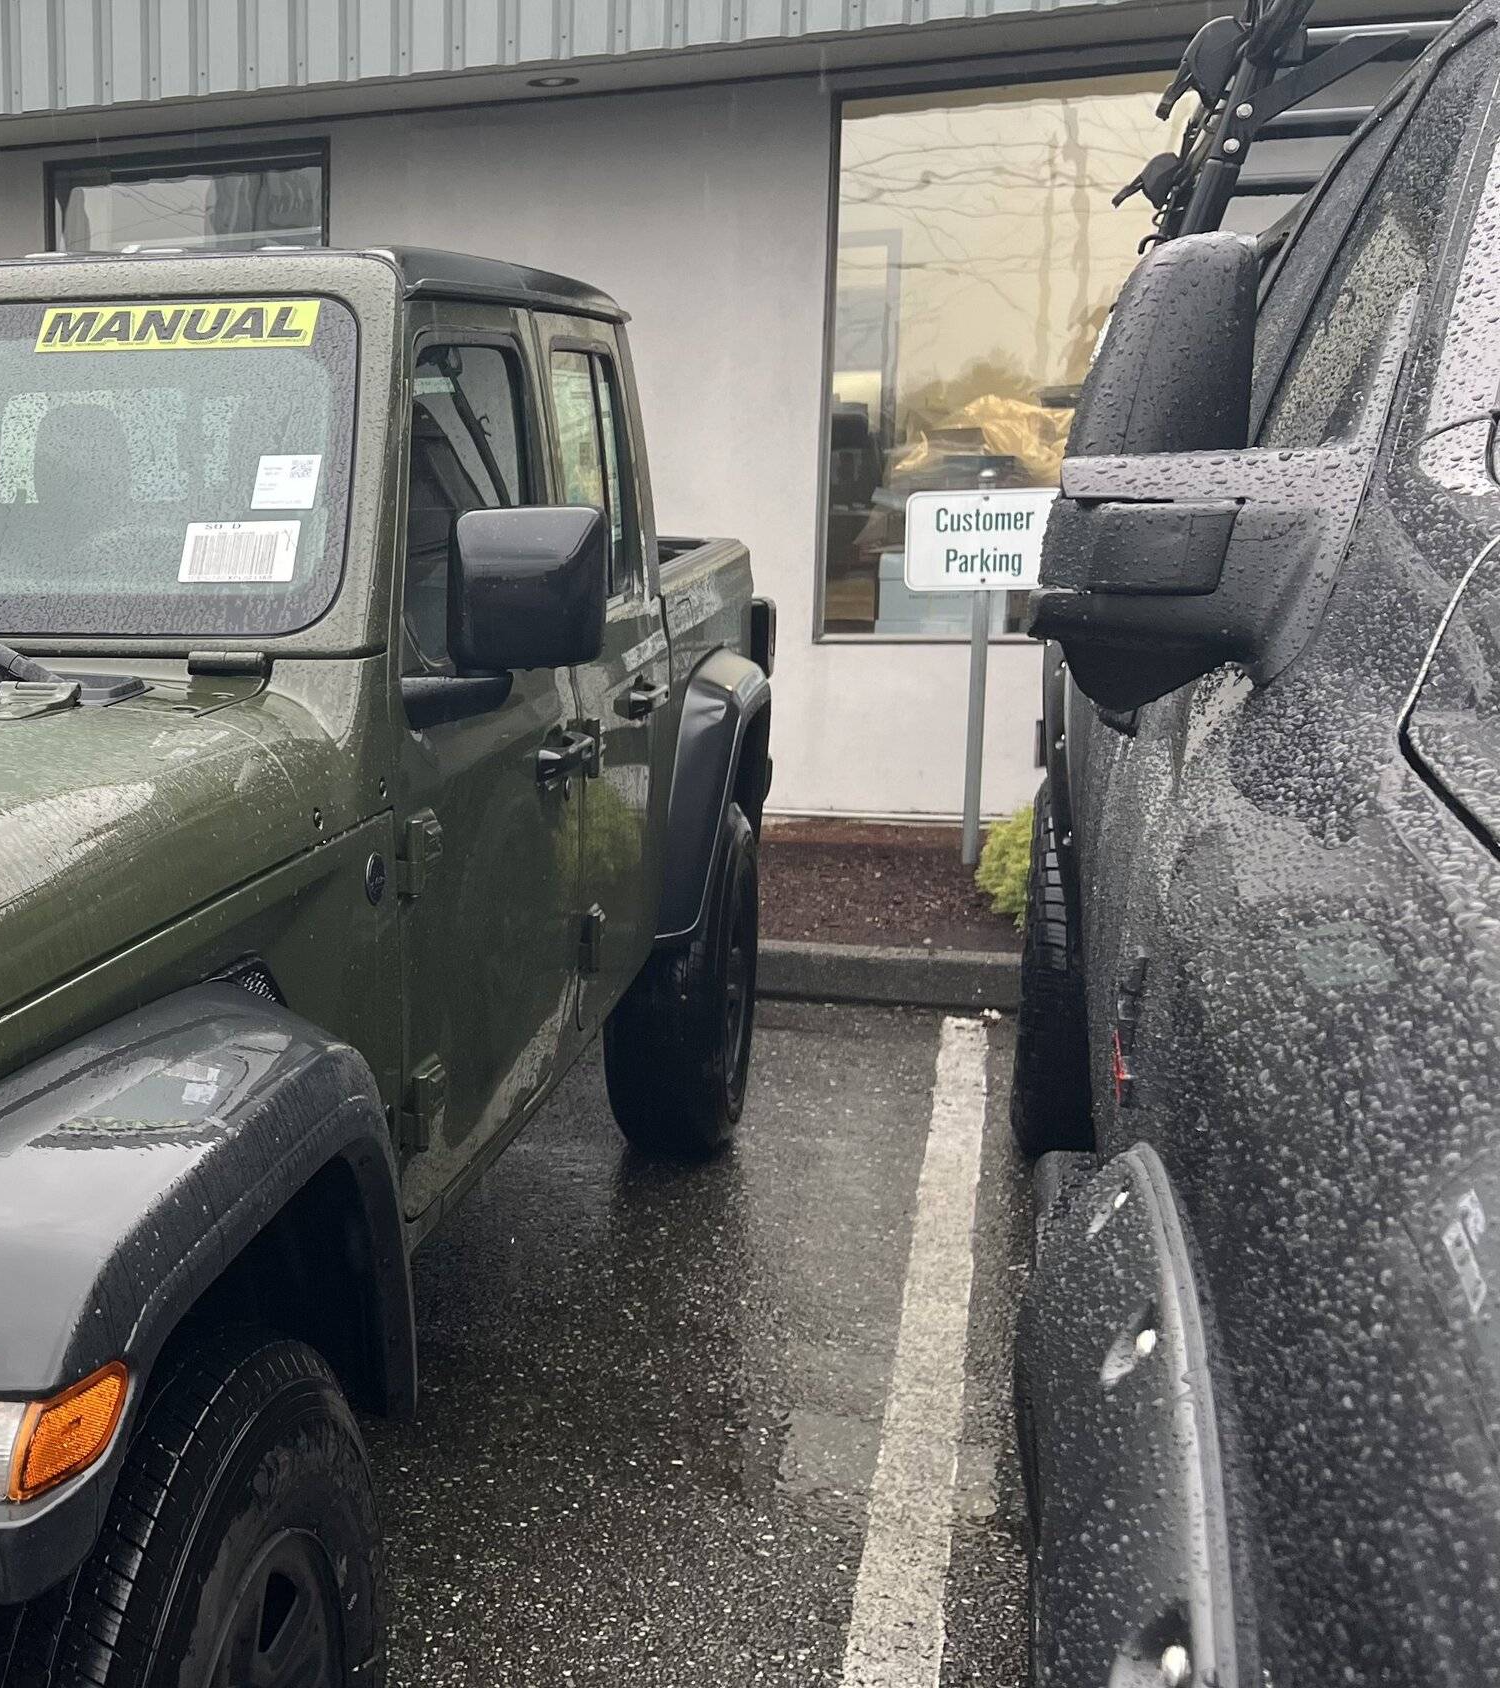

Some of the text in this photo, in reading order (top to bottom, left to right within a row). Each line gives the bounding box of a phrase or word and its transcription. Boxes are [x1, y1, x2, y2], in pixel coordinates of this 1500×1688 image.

[42, 306, 307, 345] MANUAL
[935, 507, 1035, 532] Customer
[945, 547, 1023, 577] Parking
